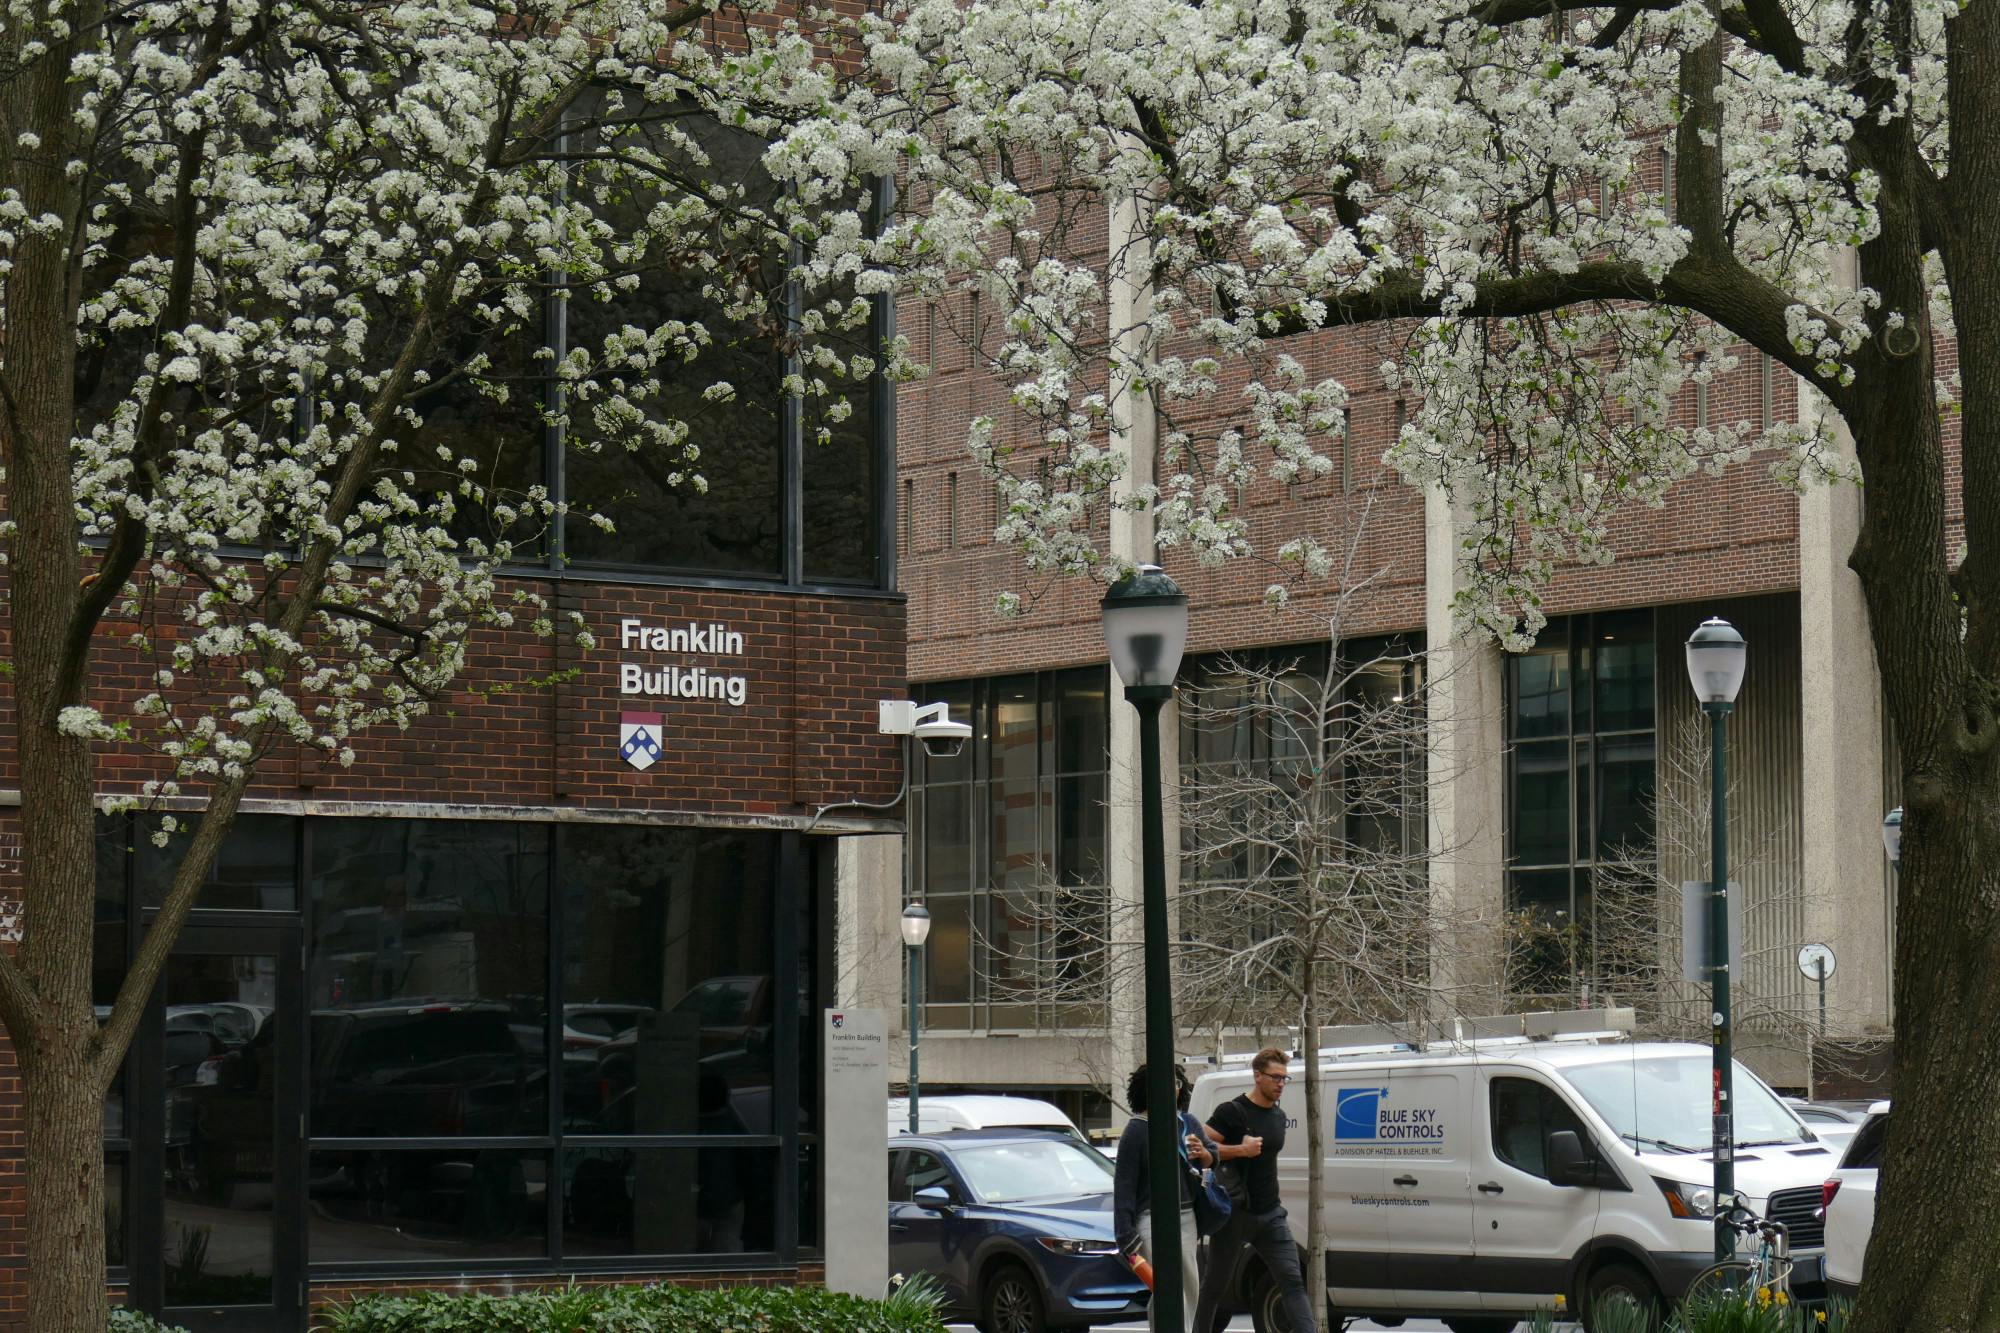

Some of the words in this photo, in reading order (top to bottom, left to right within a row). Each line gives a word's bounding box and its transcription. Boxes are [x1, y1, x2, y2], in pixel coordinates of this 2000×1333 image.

[621, 619, 743, 655] Franklin
[620, 664, 746, 706] Building
[857, 1034, 881, 1042] Building
[1380, 1110, 1407, 1122] BLUE
[1412, 1109, 1436, 1122] SKY
[1379, 1125, 1444, 1139] CONTROLS
[1375, 1148, 1396, 1156] HATZEL
[1351, 1195, 1430, 1208] blueskycontrols.com
